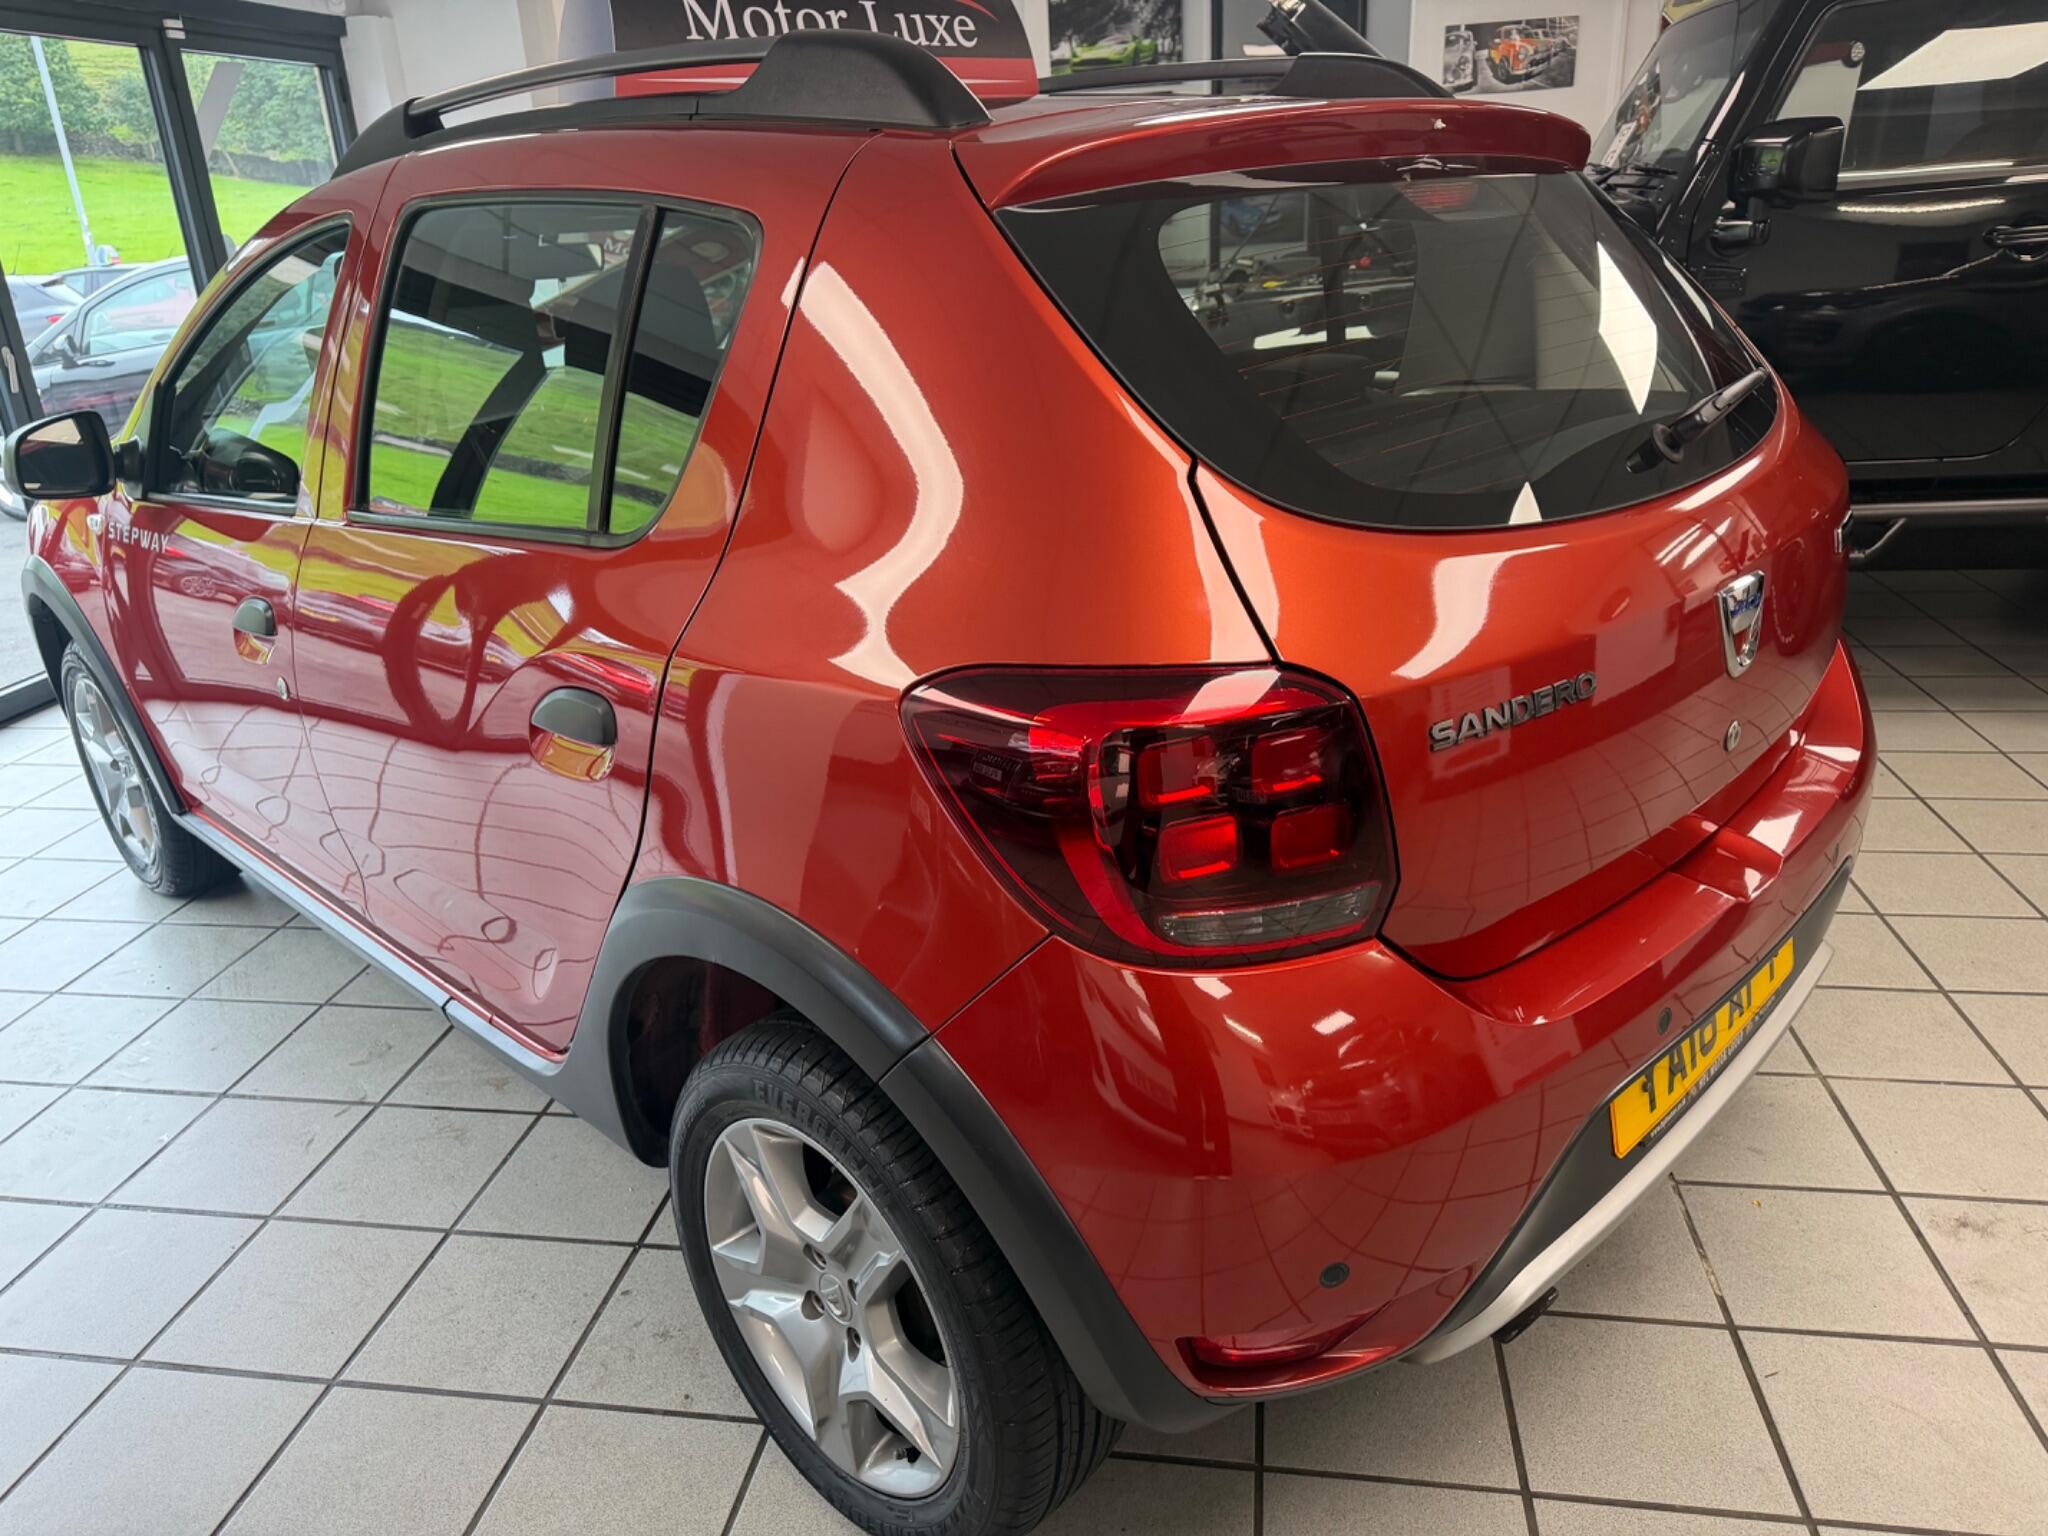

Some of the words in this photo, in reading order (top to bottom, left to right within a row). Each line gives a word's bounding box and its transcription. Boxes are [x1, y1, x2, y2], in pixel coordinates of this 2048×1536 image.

[683, 0, 848, 40] Motor
[857, 0, 978, 47] Luxe
[107, 521, 169, 554] STEPWAY
[1429, 671, 1597, 752] SANDERO
